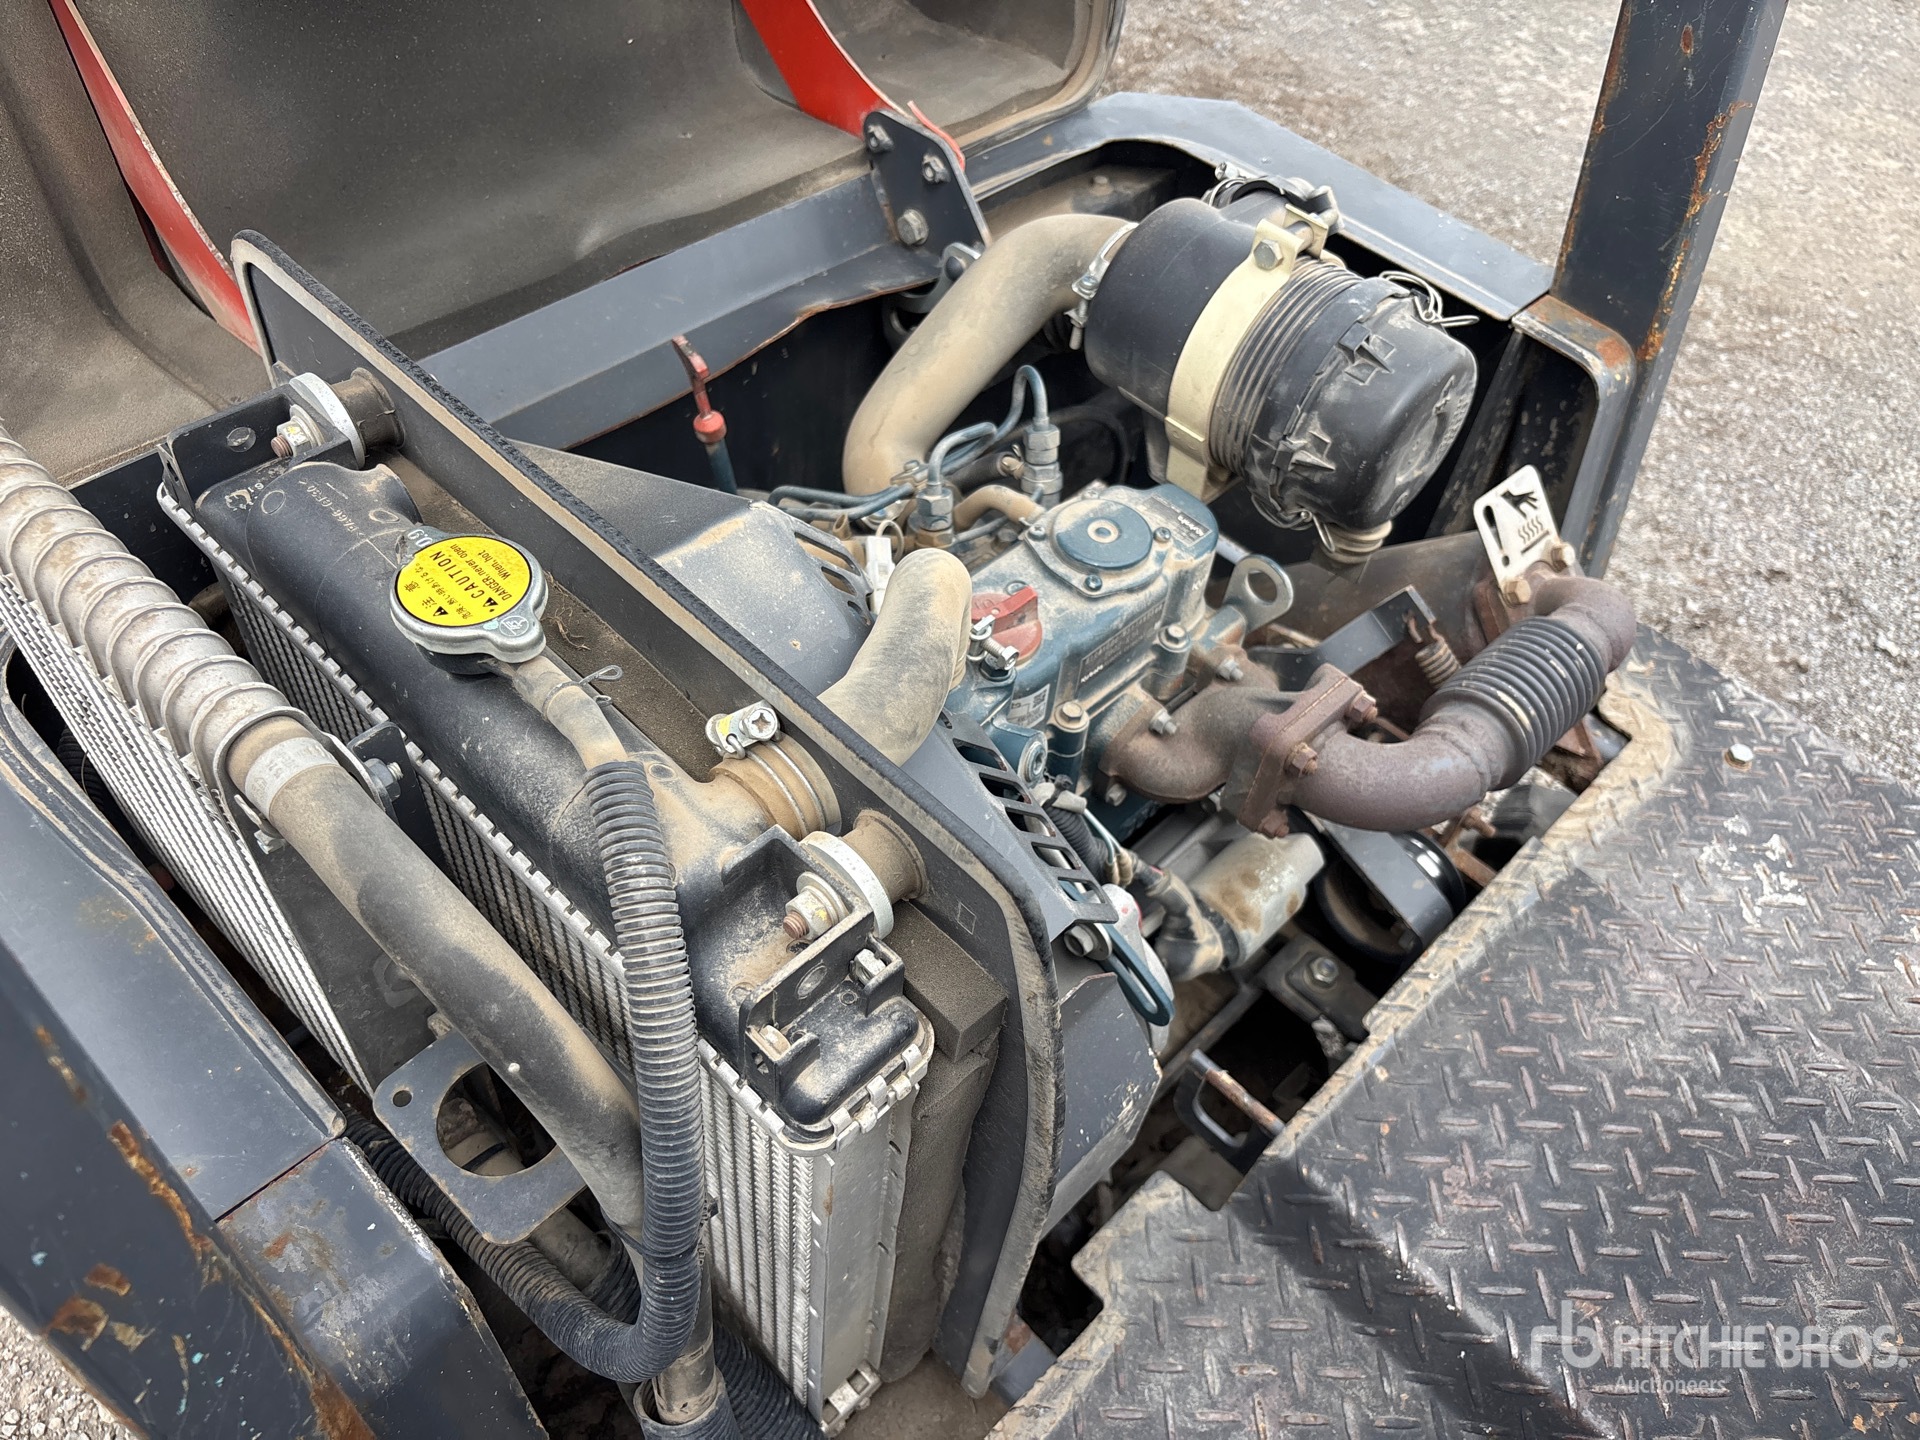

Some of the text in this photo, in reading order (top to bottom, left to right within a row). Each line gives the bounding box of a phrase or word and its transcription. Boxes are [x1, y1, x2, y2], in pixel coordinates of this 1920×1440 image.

[407, 528, 434, 548] 0.9
[449, 544, 468, 559] open
[477, 549, 494, 563] hot
[429, 550, 486, 599] CAUTION
[467, 559, 487, 576] never
